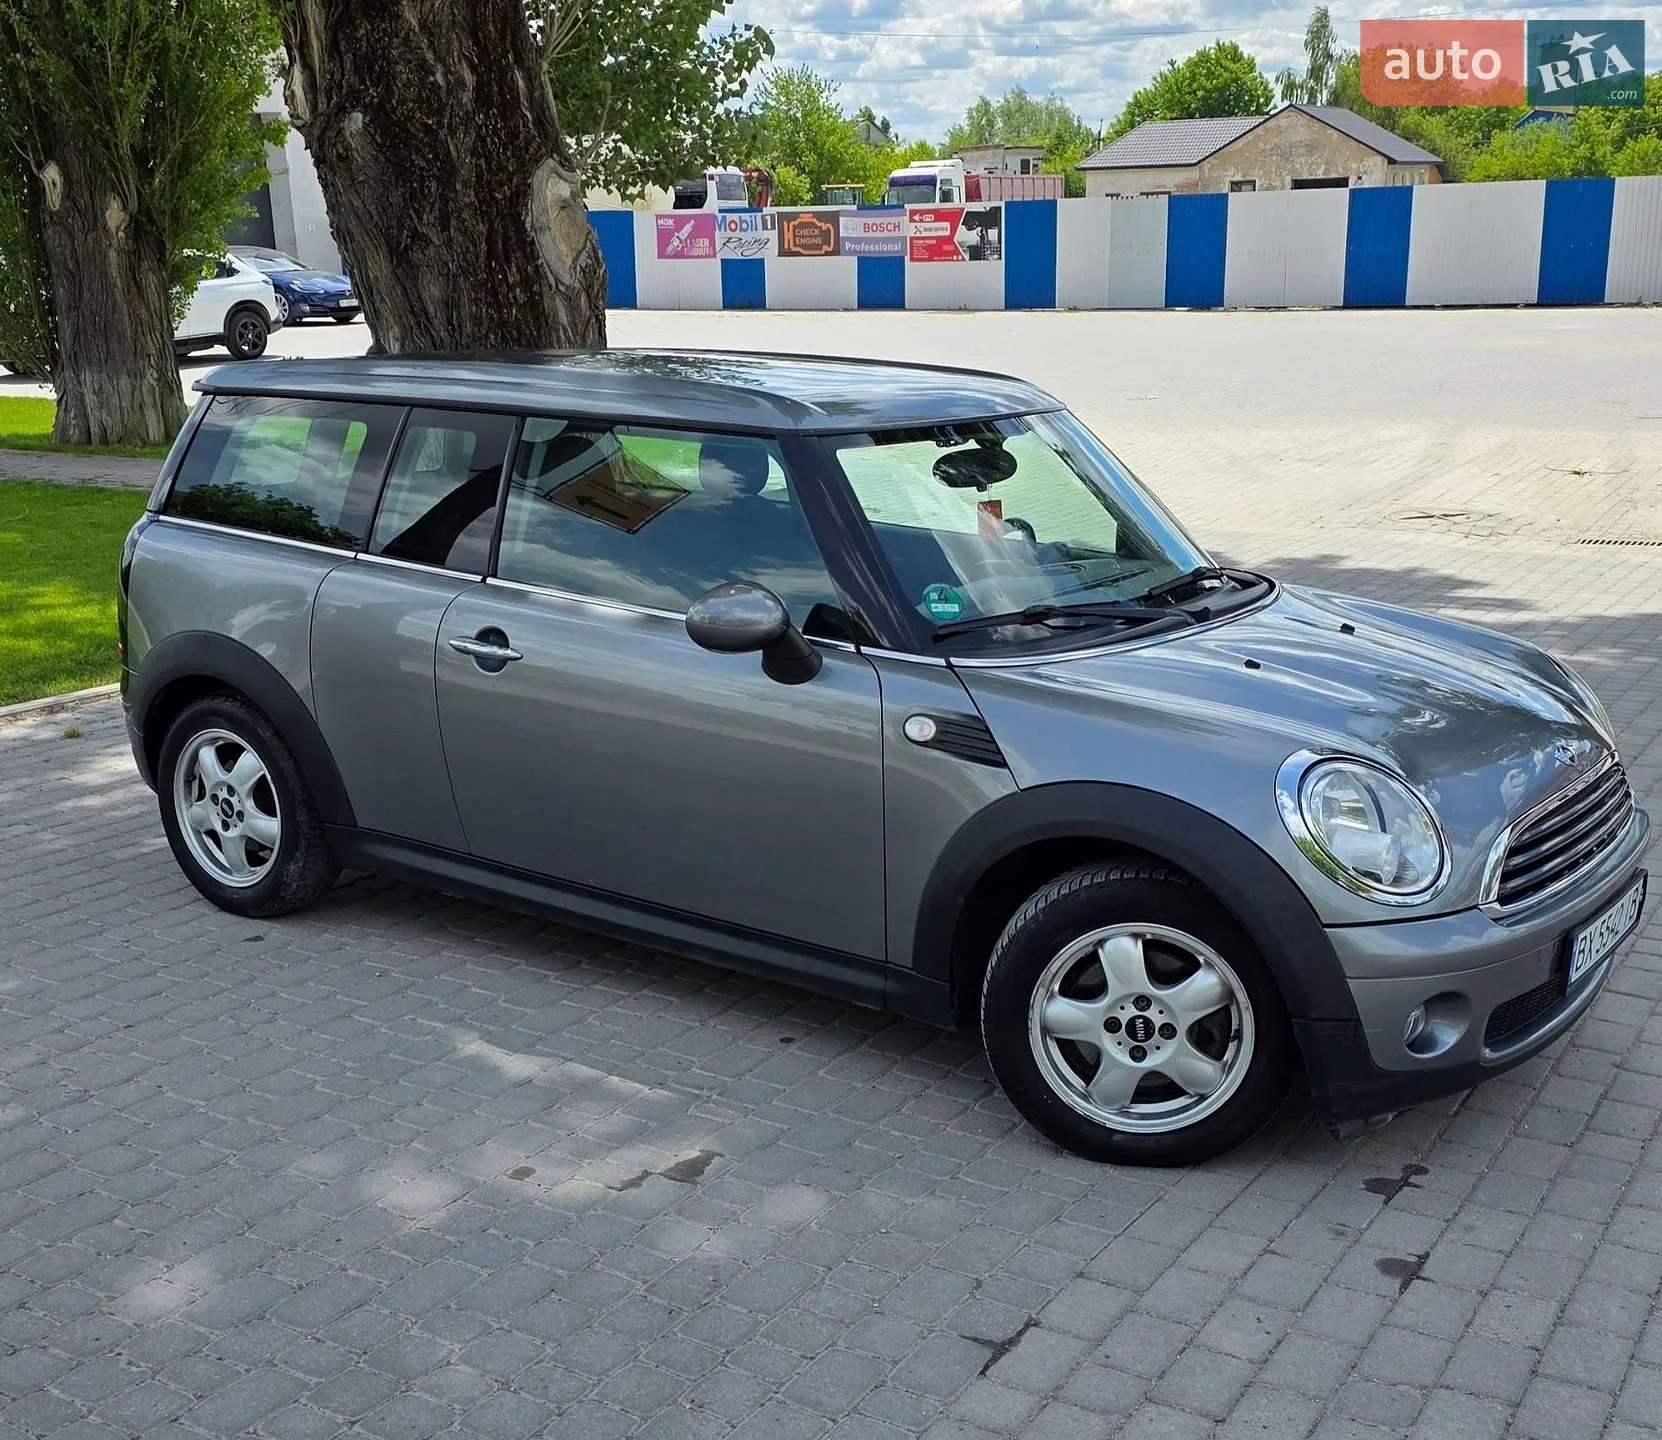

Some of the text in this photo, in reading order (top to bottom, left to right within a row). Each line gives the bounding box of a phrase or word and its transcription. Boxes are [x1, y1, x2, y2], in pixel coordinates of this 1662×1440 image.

[715, 213, 758, 233] Mobil
[863, 221, 901, 233] BOSCH
[795, 228, 820, 236] CHECK
[716, 236, 770, 257] Racing
[796, 237, 823, 245] ENGINE
[845, 241, 902, 252] Professional
[1135, 1018, 1146, 1041] MINI
